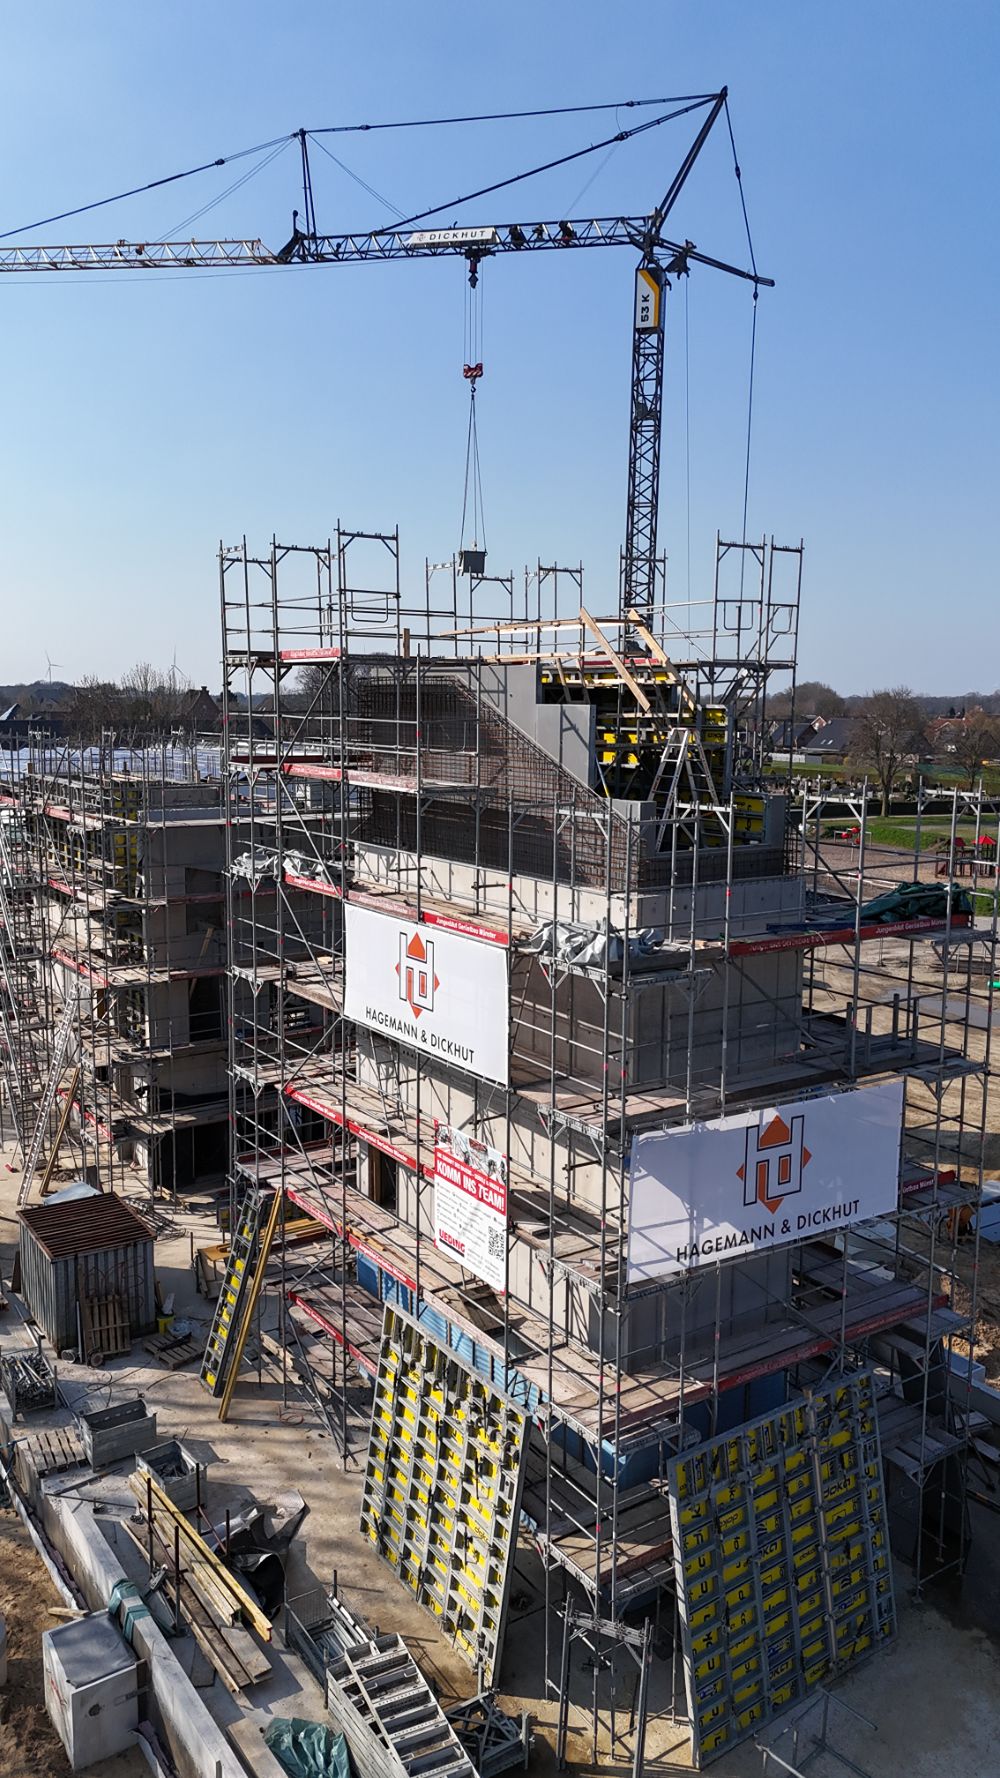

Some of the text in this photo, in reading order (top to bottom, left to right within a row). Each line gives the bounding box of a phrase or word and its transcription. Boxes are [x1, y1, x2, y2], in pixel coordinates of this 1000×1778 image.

[429, 230, 486, 241] DICKHUT
[640, 293, 650, 322] 53 K
[365, 1006, 475, 1063] HAGEMANN & DICKHUT
[436, 1159, 462, 1185] KOMM
[462, 1174, 477, 1194] INS
[477, 1183, 505, 1212] TEAM!
[676, 1200, 860, 1263] HAGEMANN & DICKHUT
